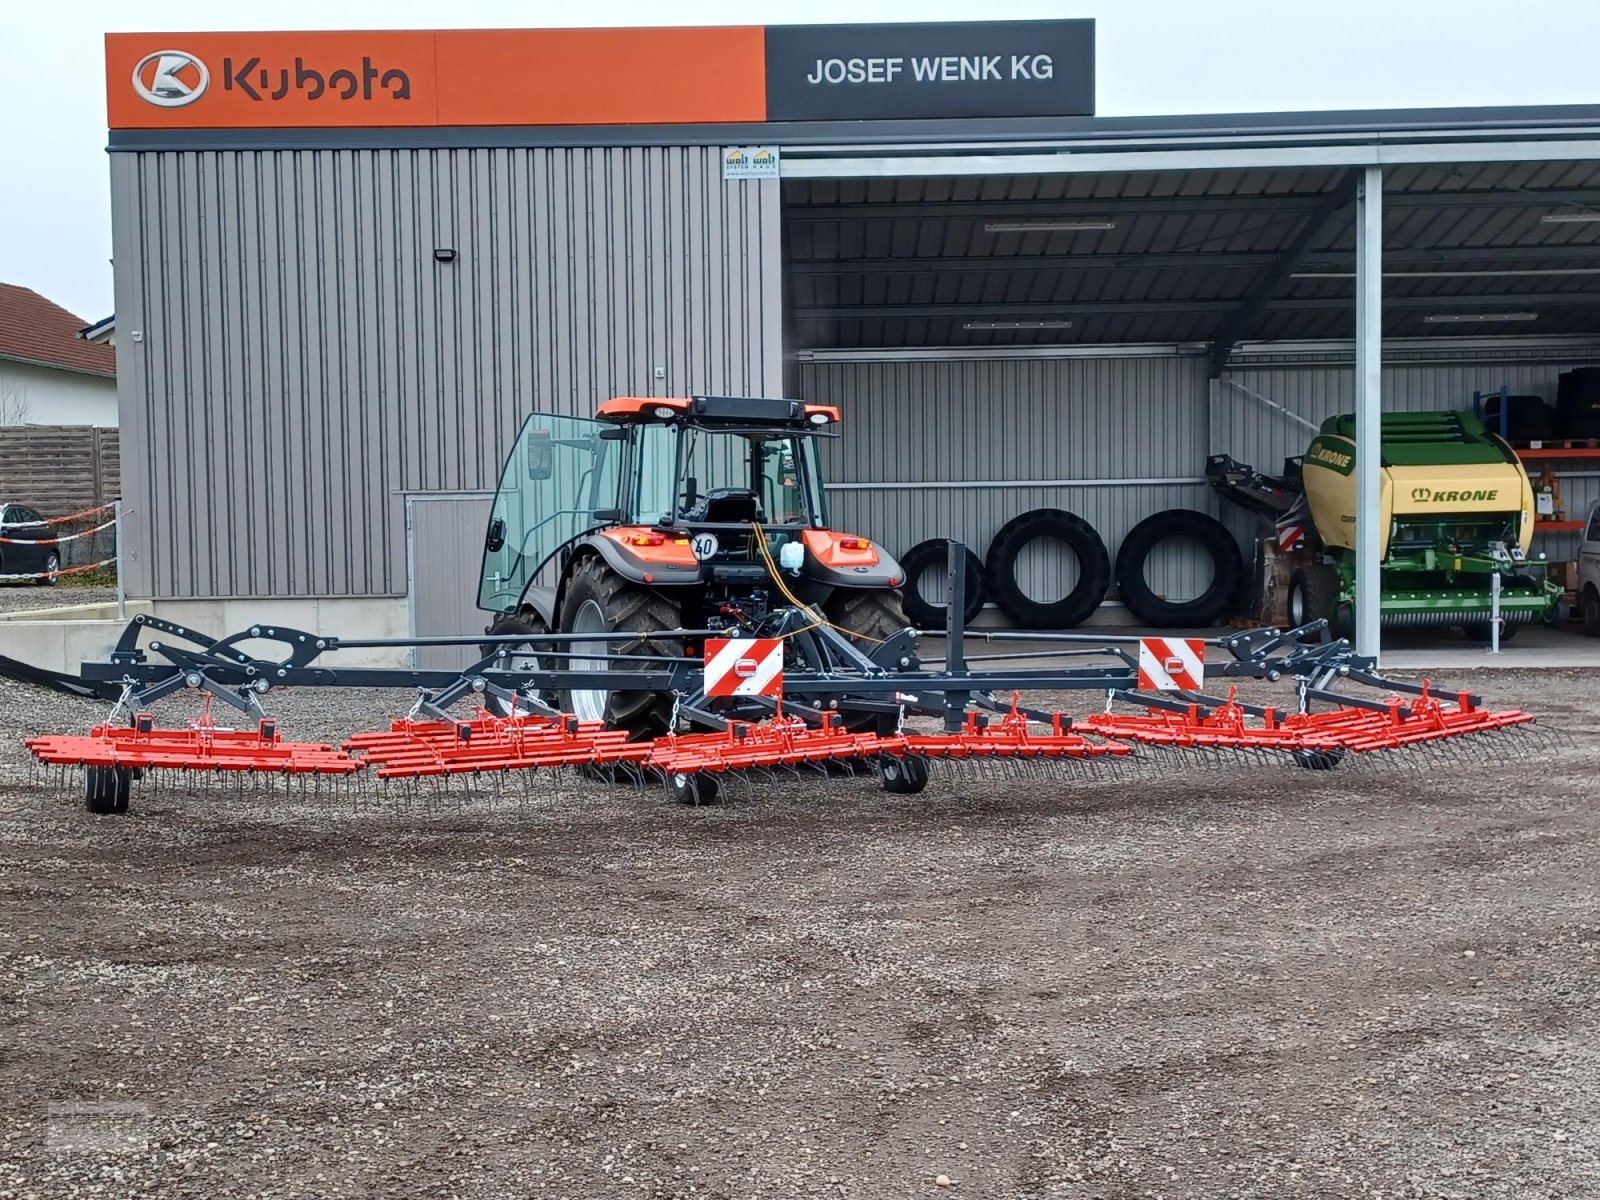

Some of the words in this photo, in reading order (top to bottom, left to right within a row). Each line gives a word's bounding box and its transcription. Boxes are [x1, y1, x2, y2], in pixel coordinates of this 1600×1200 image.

[223, 56, 411, 101] Kubota
[807, 58, 903, 84] JOSEF
[911, 55, 1002, 81] WENK
[1011, 54, 1053, 79] KG
[1317, 448, 1352, 468] KRONE
[1432, 490, 1498, 502] KRONE
[695, 539, 712, 555] 40
